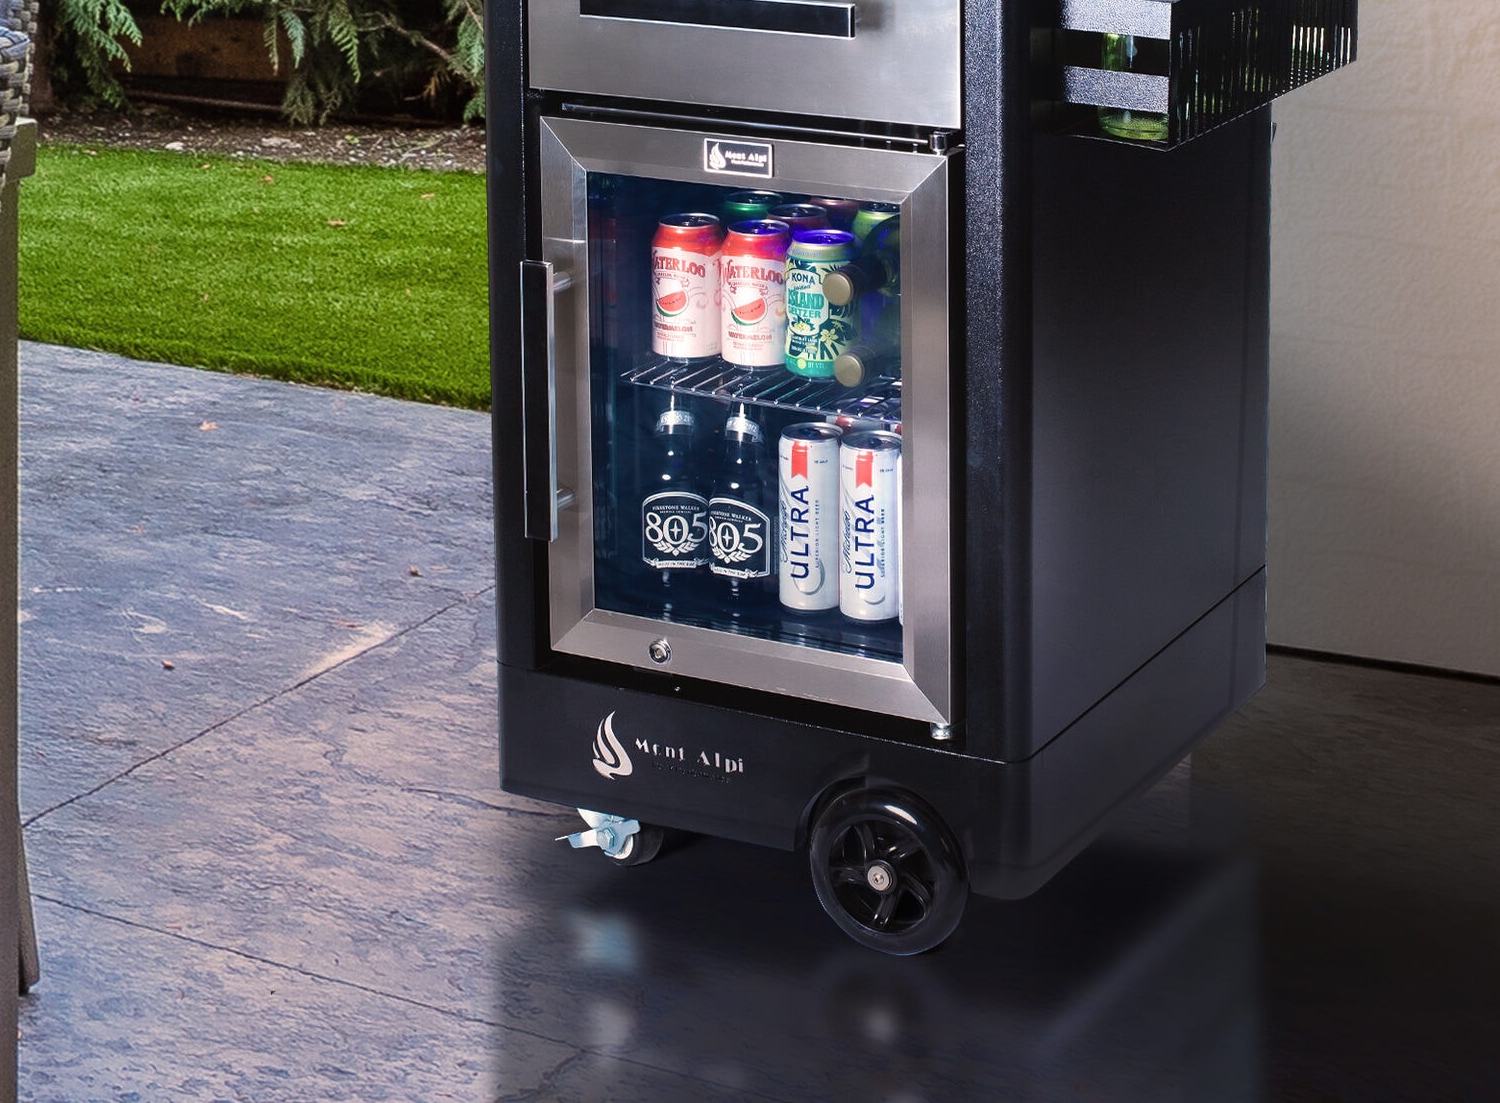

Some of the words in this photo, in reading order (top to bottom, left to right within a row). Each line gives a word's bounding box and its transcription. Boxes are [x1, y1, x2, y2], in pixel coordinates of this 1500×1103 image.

[724, 259, 784, 285] WATERLOO
[791, 272, 816, 285] KONA
[788, 289, 825, 309] ISLAND
[645, 511, 708, 545] 805
[731, 513, 752, 521] WALKER
[709, 516, 763, 554] 805
[790, 486, 809, 579] ULTRA
[855, 495, 875, 589] ULTRA
[697, 751, 744, 773] Alpi
